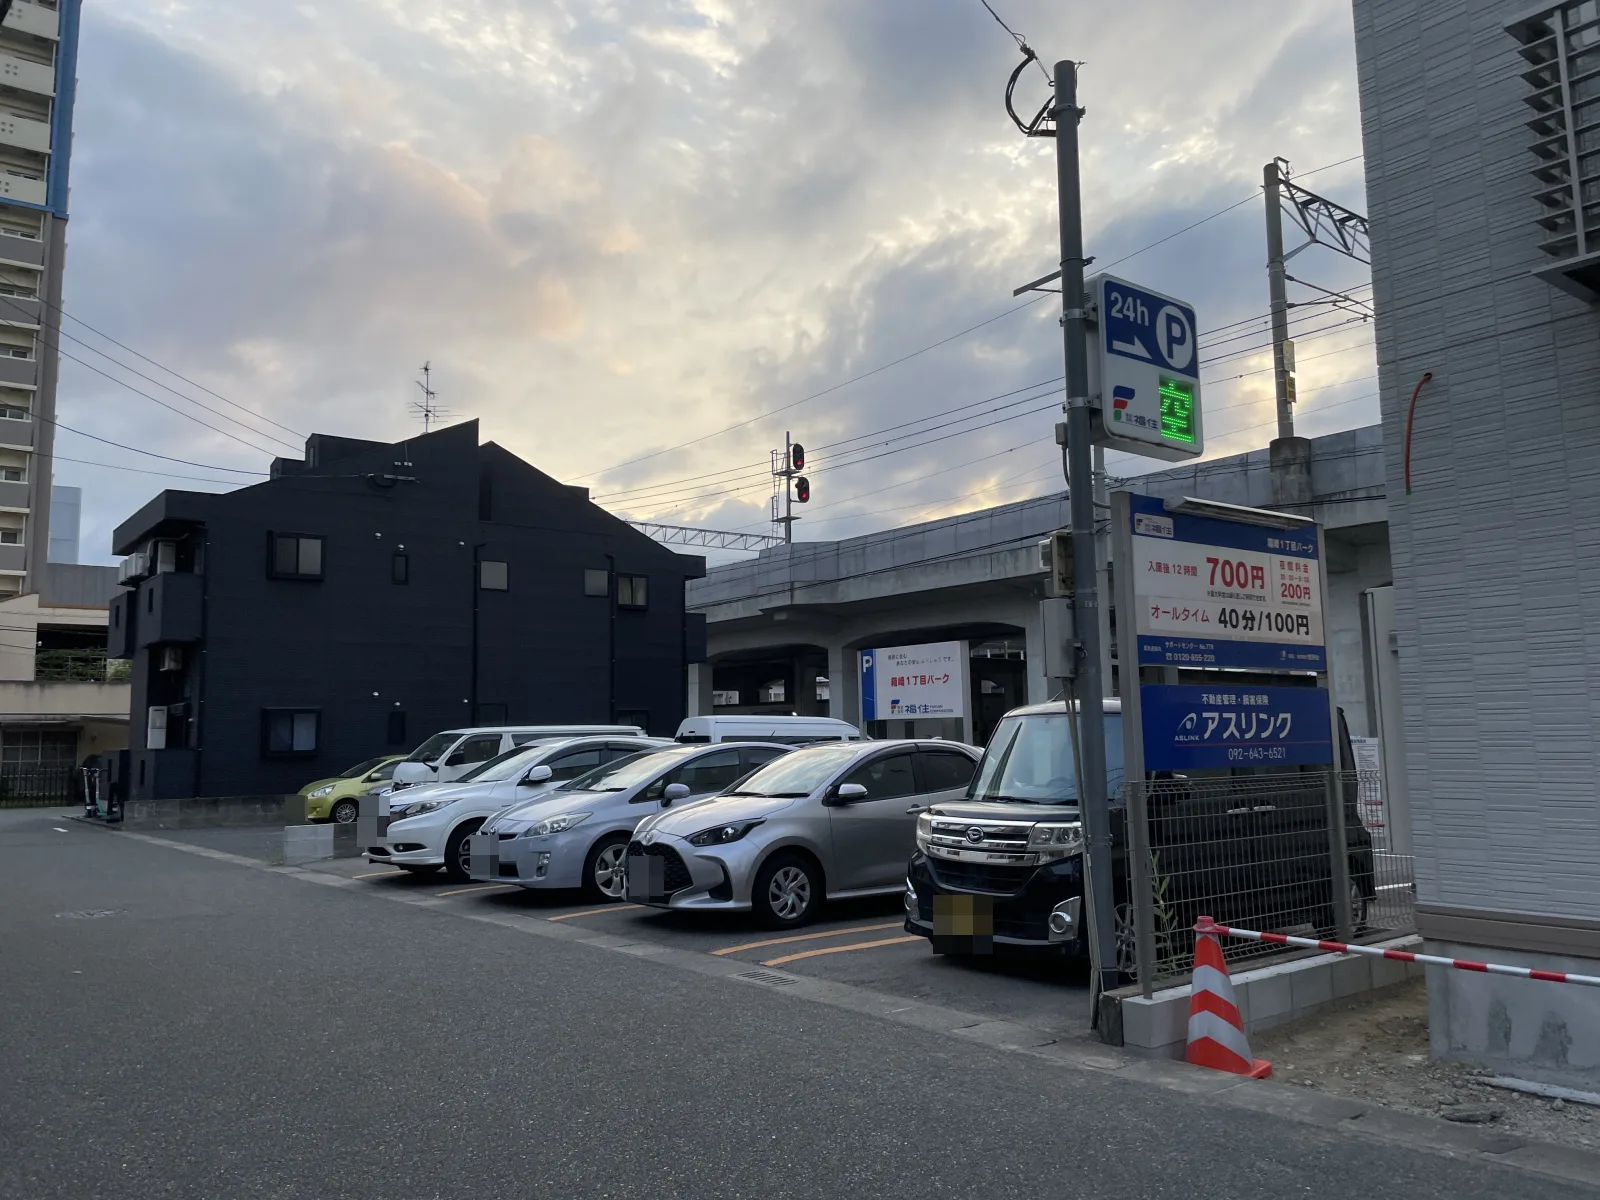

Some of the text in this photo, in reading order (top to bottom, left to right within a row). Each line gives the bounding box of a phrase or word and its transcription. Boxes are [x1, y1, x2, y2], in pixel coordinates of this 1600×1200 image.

[1110, 292, 1149, 326] 24h
[1165, 312, 1187, 360] P
[1159, 380, 1192, 443] 空
[1205, 556, 1265, 589] 700円
[1280, 582, 1311, 601] 200円
[1151, 604, 1210, 623] オールタイム
[1218, 607, 1310, 636] 40分/100円
[862, 655, 872, 673] P
[904, 703, 930, 714] 福住
[1201, 711, 1292, 740] アスリンク
[1228, 746, 1286, 760] 092-643-6521
